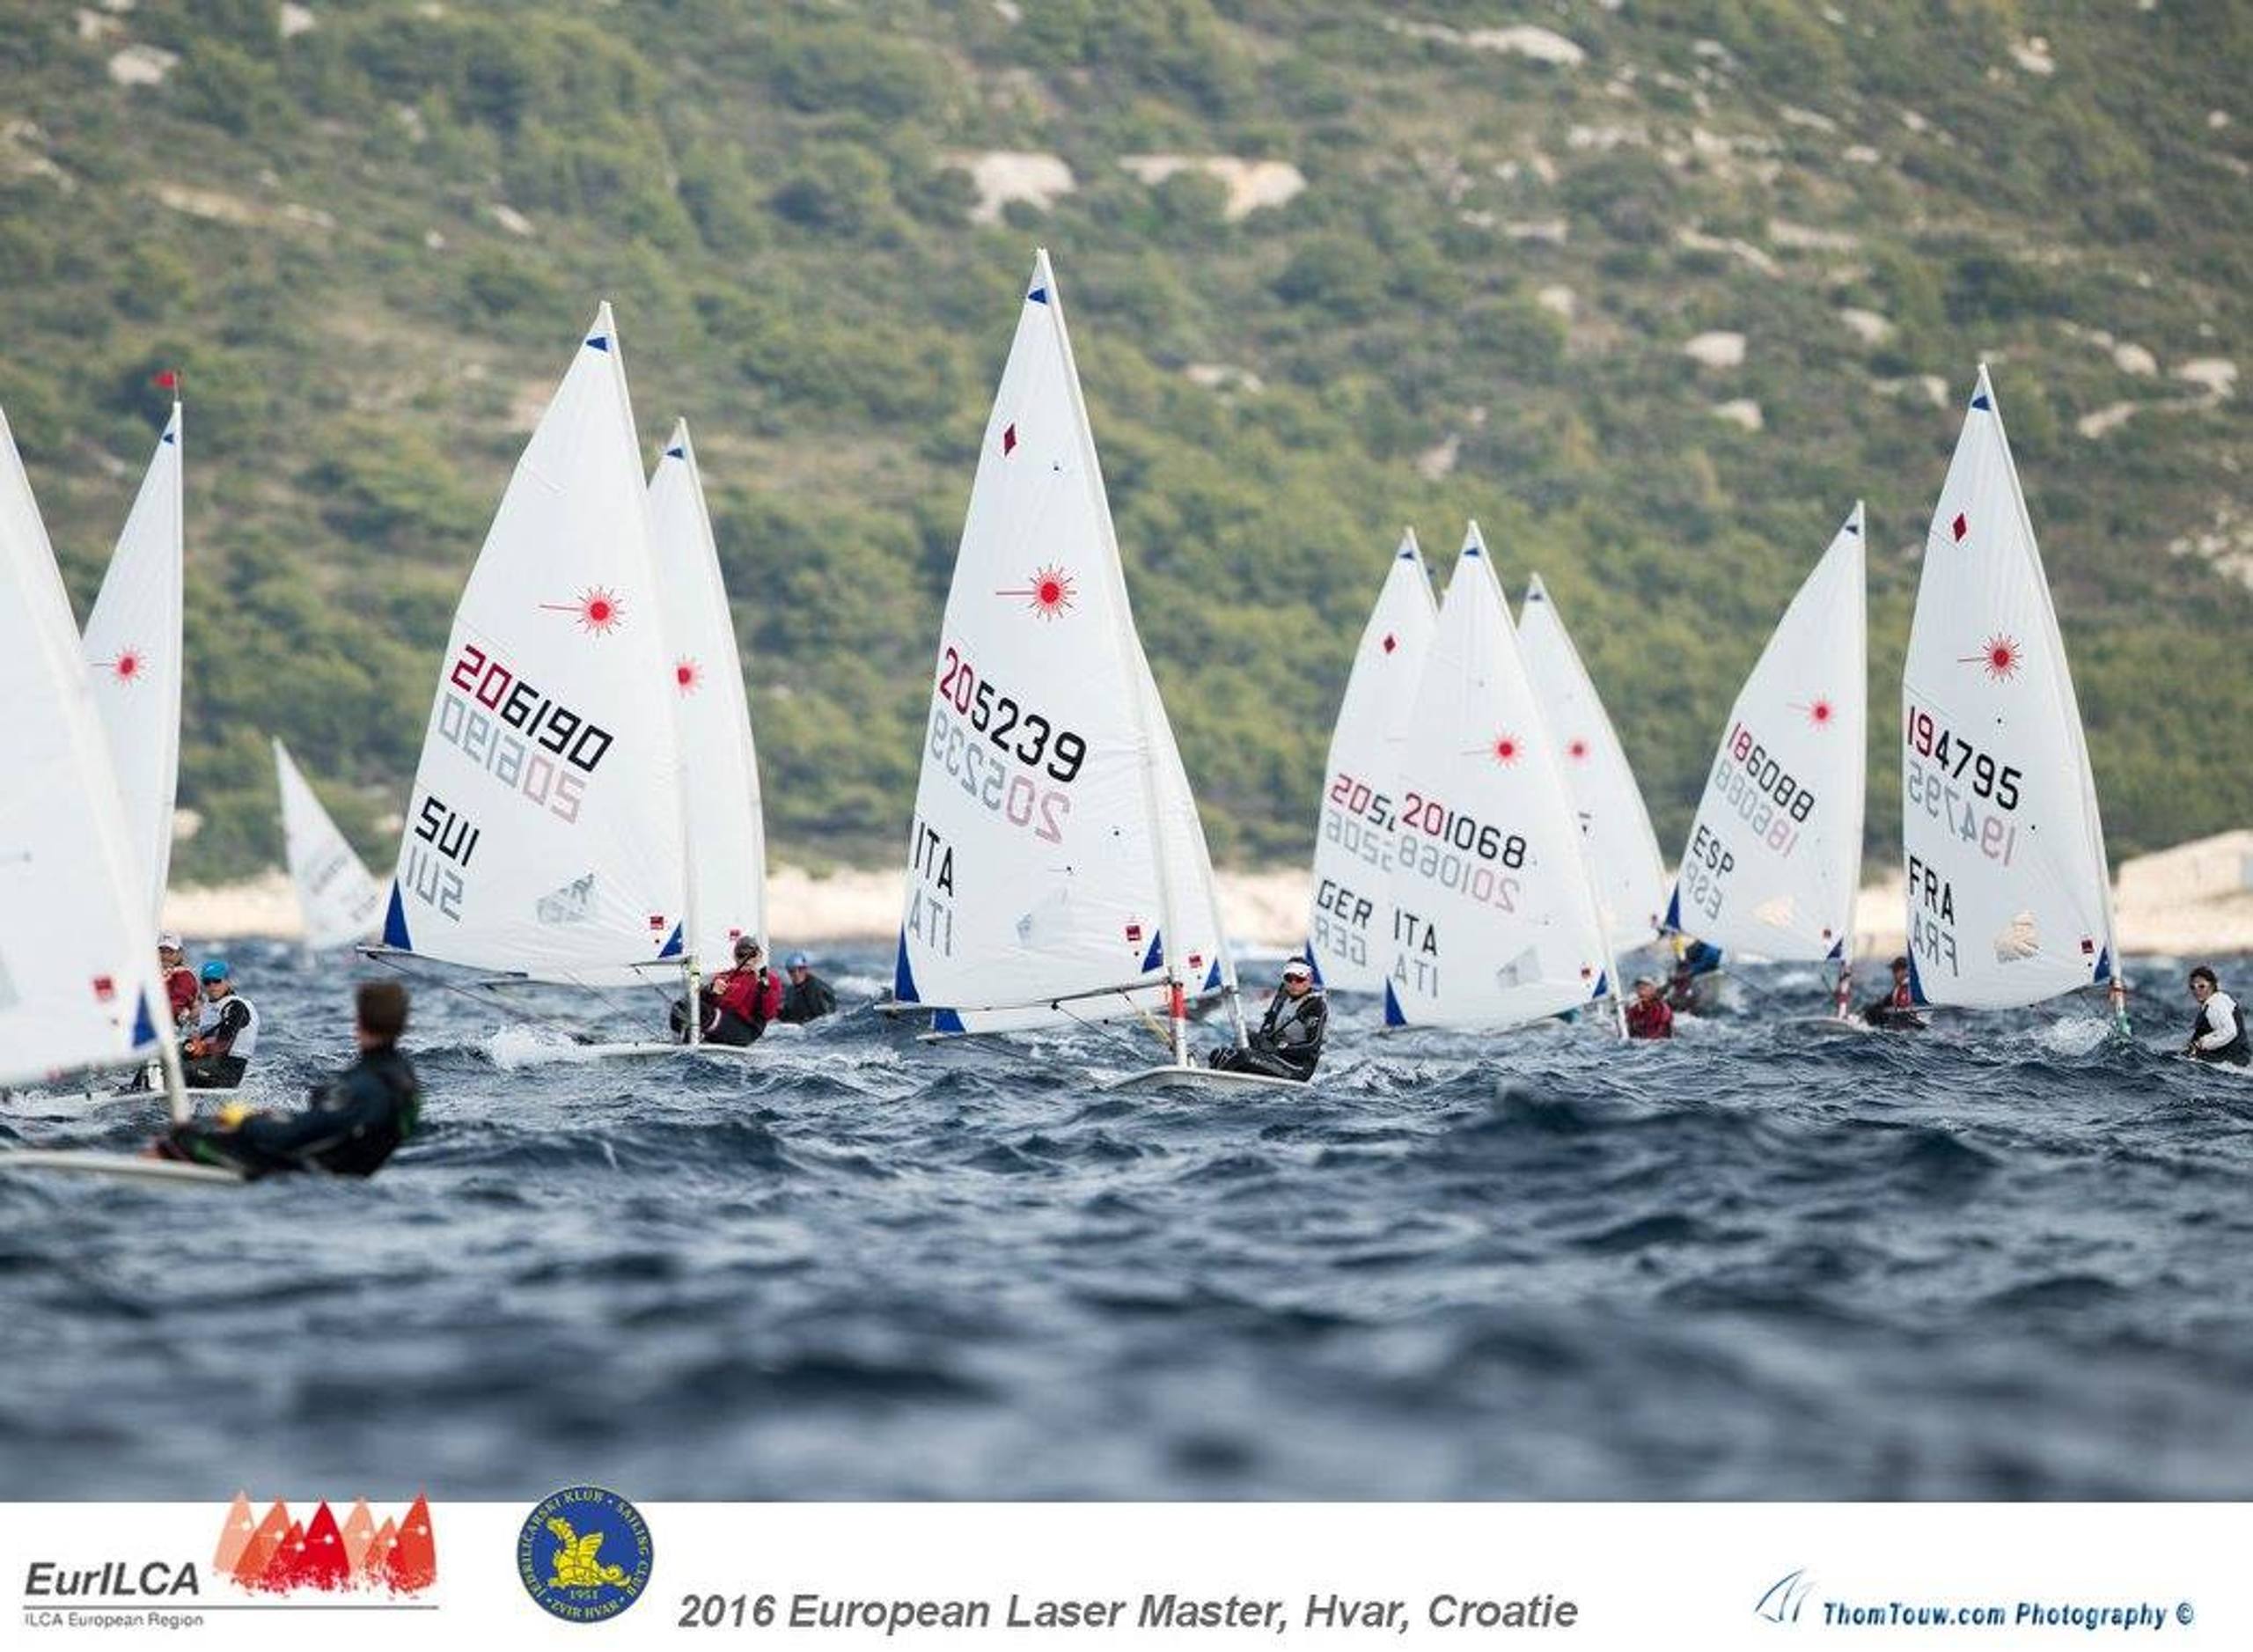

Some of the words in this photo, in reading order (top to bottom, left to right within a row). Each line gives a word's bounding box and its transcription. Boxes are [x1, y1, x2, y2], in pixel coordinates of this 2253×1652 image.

[451, 644, 613, 772] 206190
[940, 647, 1086, 782] 205239
[1728, 723, 1815, 822] 186088
[1908, 706, 2022, 810] 194795
[415, 796, 480, 867] SUI
[914, 822, 953, 897] ITA
[1402, 792, 1526, 869] 201068
[1693, 825, 1735, 879] ESP
[1317, 880, 1372, 929] GER
[1910, 855, 1955, 925] FRA
[1394, 908, 1437, 956] ITA
